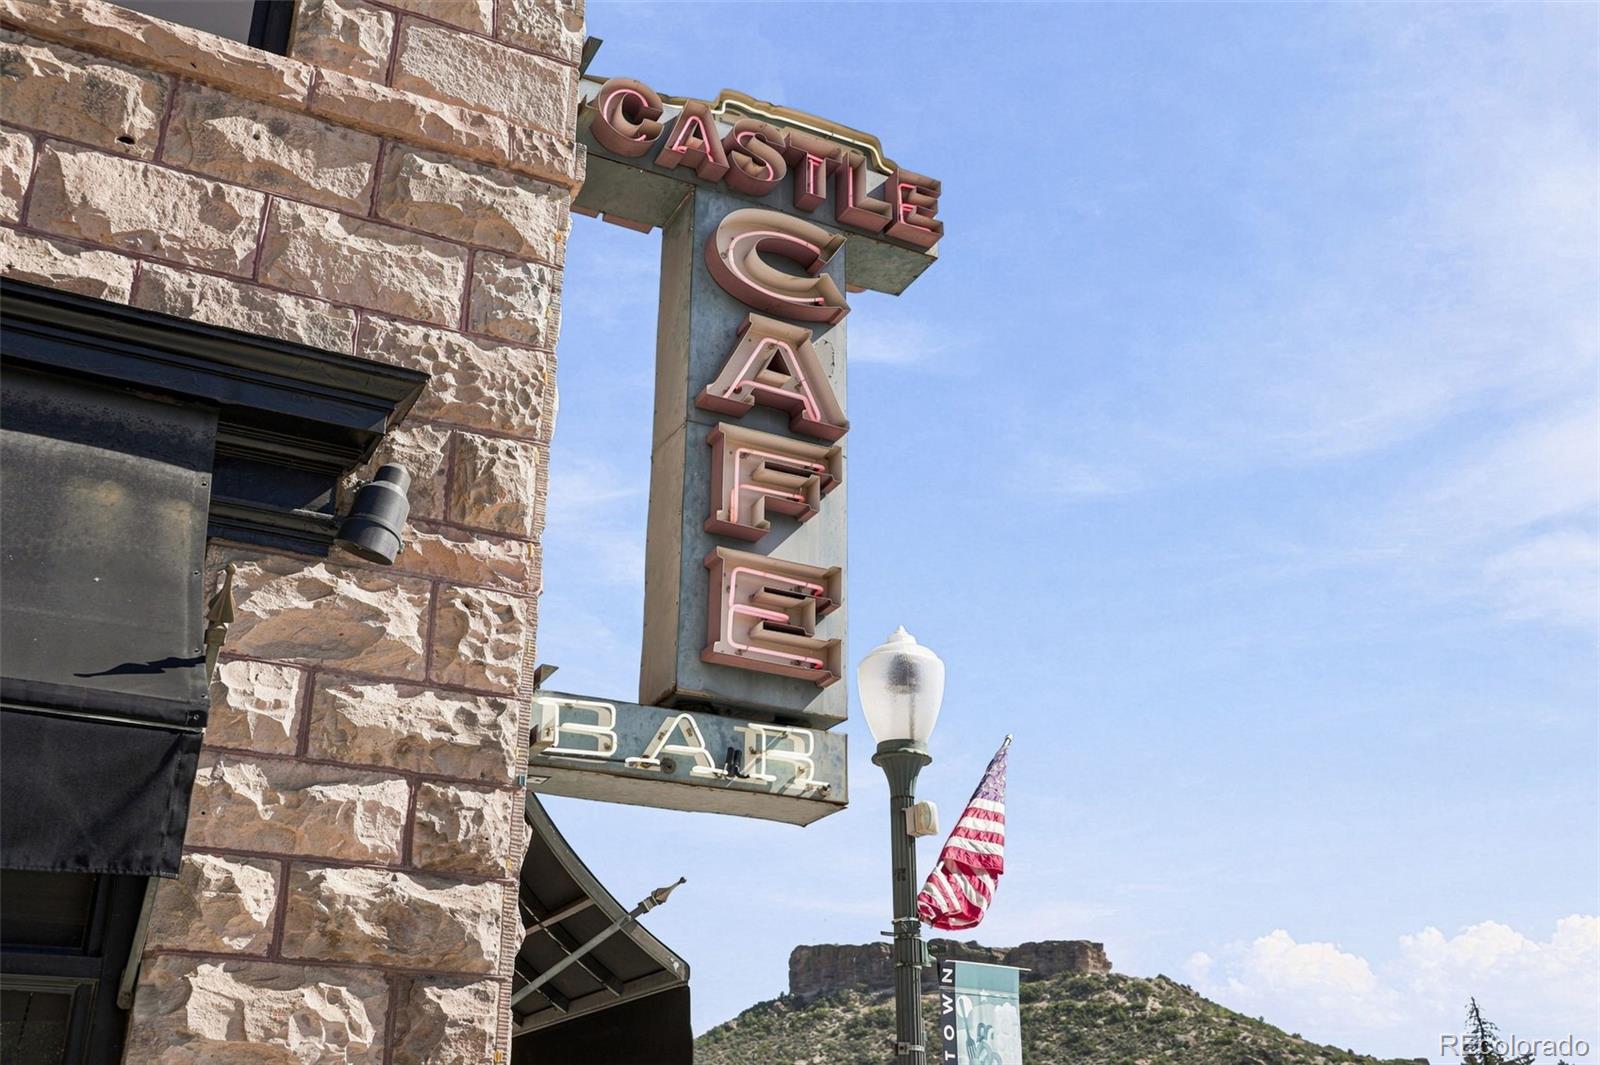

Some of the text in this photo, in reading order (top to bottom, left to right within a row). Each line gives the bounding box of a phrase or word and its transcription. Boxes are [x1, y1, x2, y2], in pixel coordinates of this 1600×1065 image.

[590, 77, 944, 252] CASTLE
[695, 207, 851, 688] CAFE
[532, 696, 831, 797] BAR
